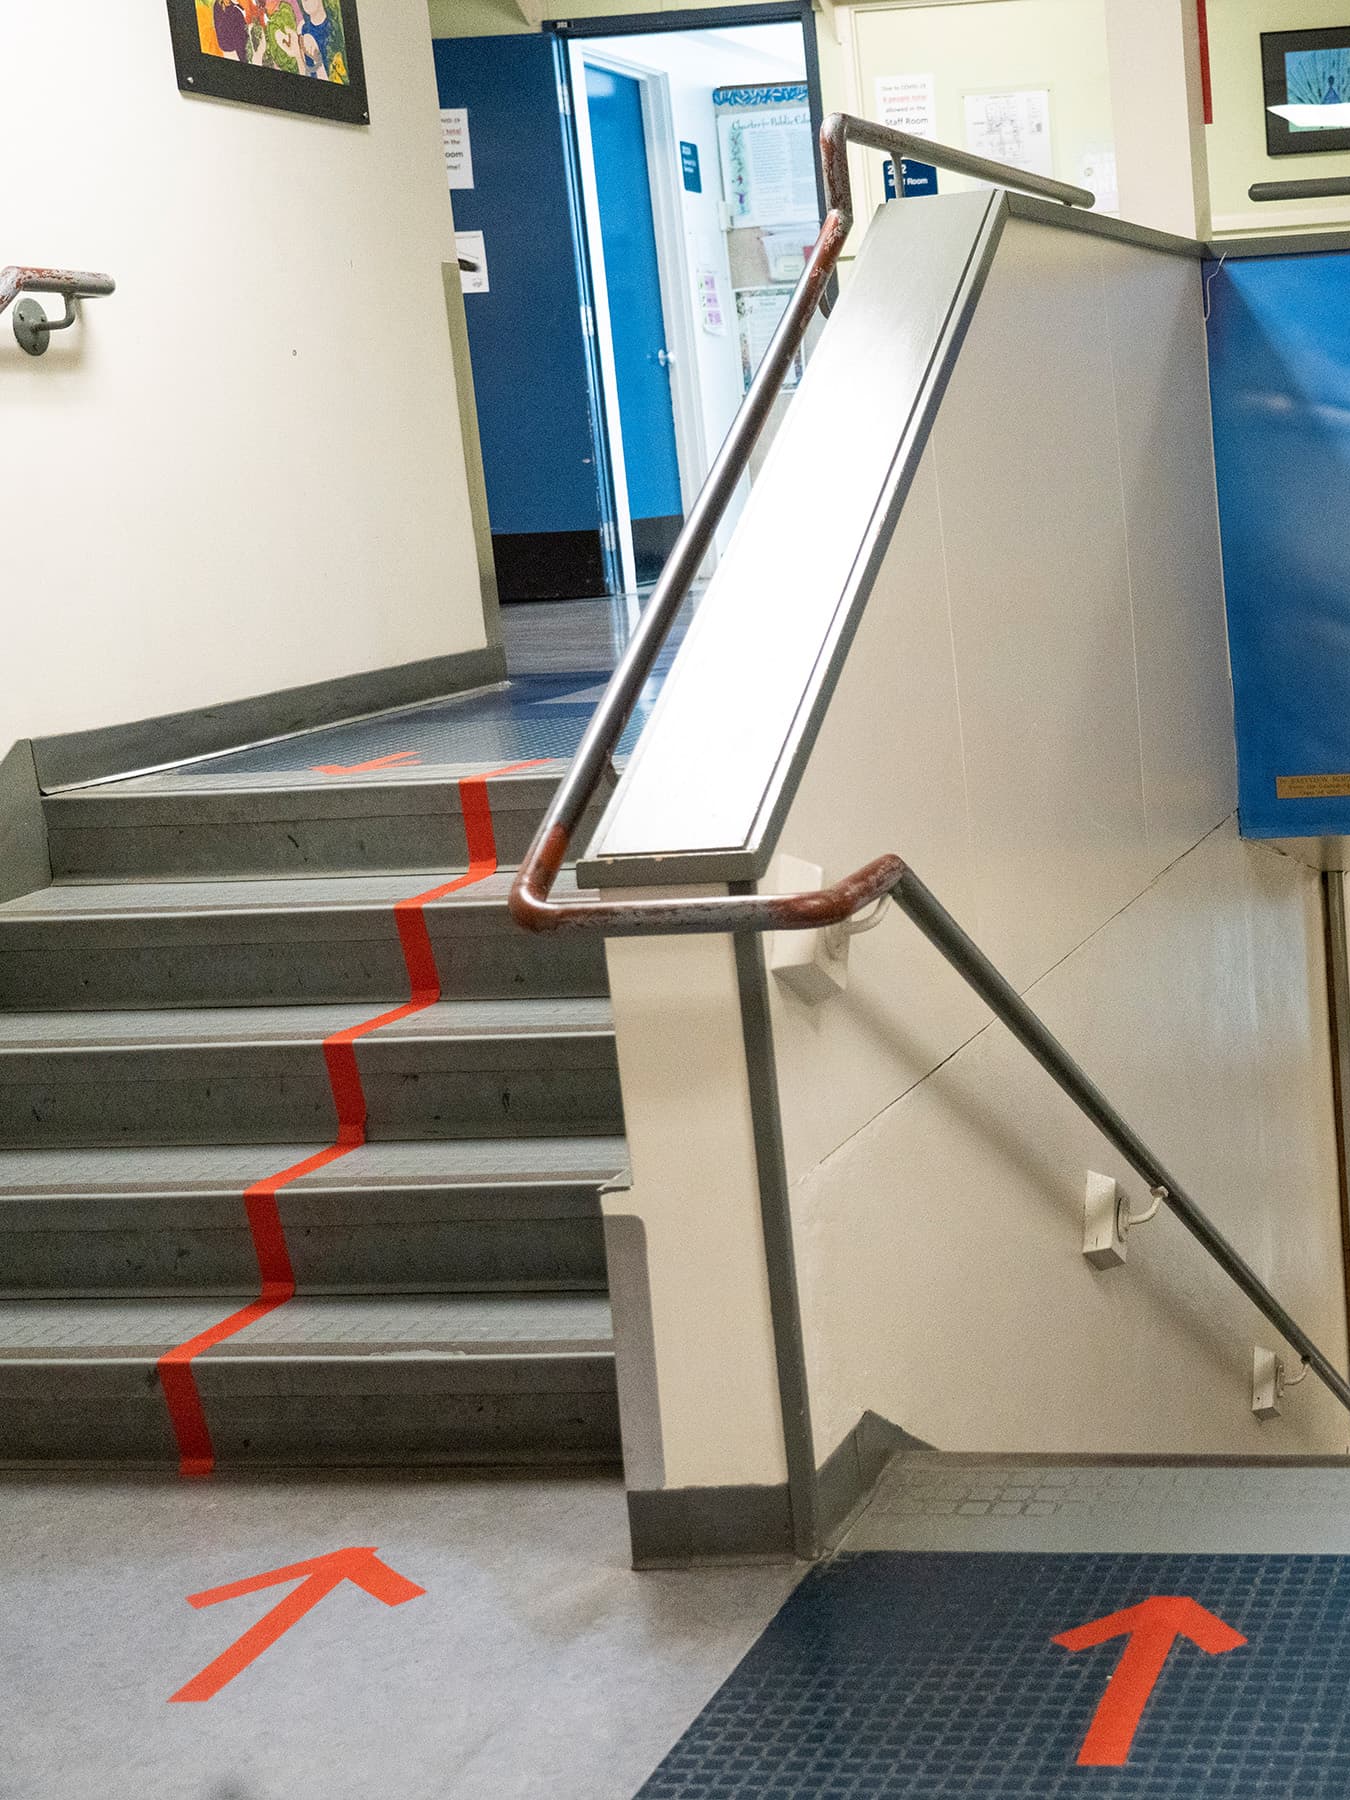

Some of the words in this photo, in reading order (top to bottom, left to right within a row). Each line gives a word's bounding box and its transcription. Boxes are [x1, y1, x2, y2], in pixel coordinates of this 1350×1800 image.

[885, 118, 903, 127] Staff
[906, 117, 928, 125] Room
[445, 151, 464, 159] oom
[887, 164, 907, 175] 22
[907, 178, 928, 186] Room
